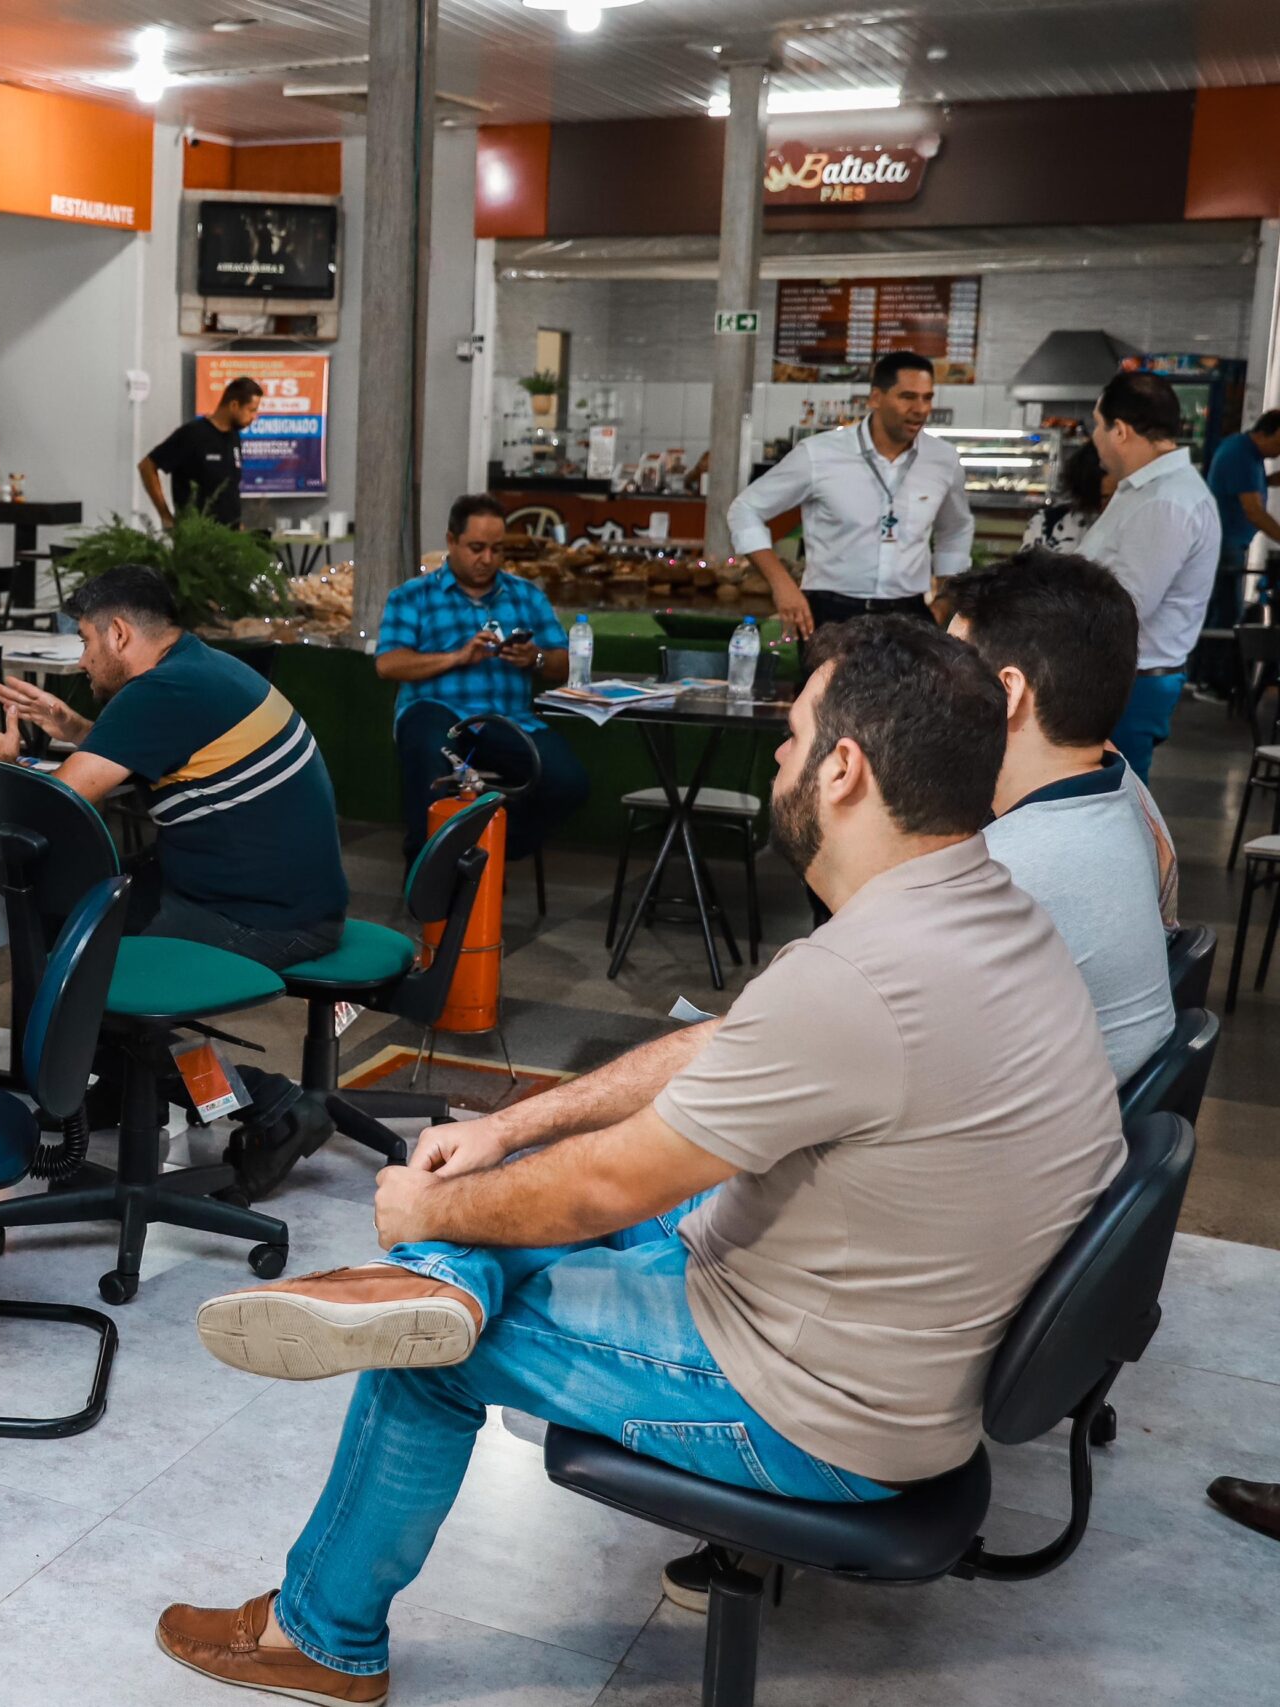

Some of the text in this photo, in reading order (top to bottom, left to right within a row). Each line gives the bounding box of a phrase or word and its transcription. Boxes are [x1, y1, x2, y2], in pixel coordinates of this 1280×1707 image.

[795, 152, 911, 189] Batista
[50, 194, 136, 226] RESTAURANTE
[251, 418, 319, 435] CONSIGNADO
